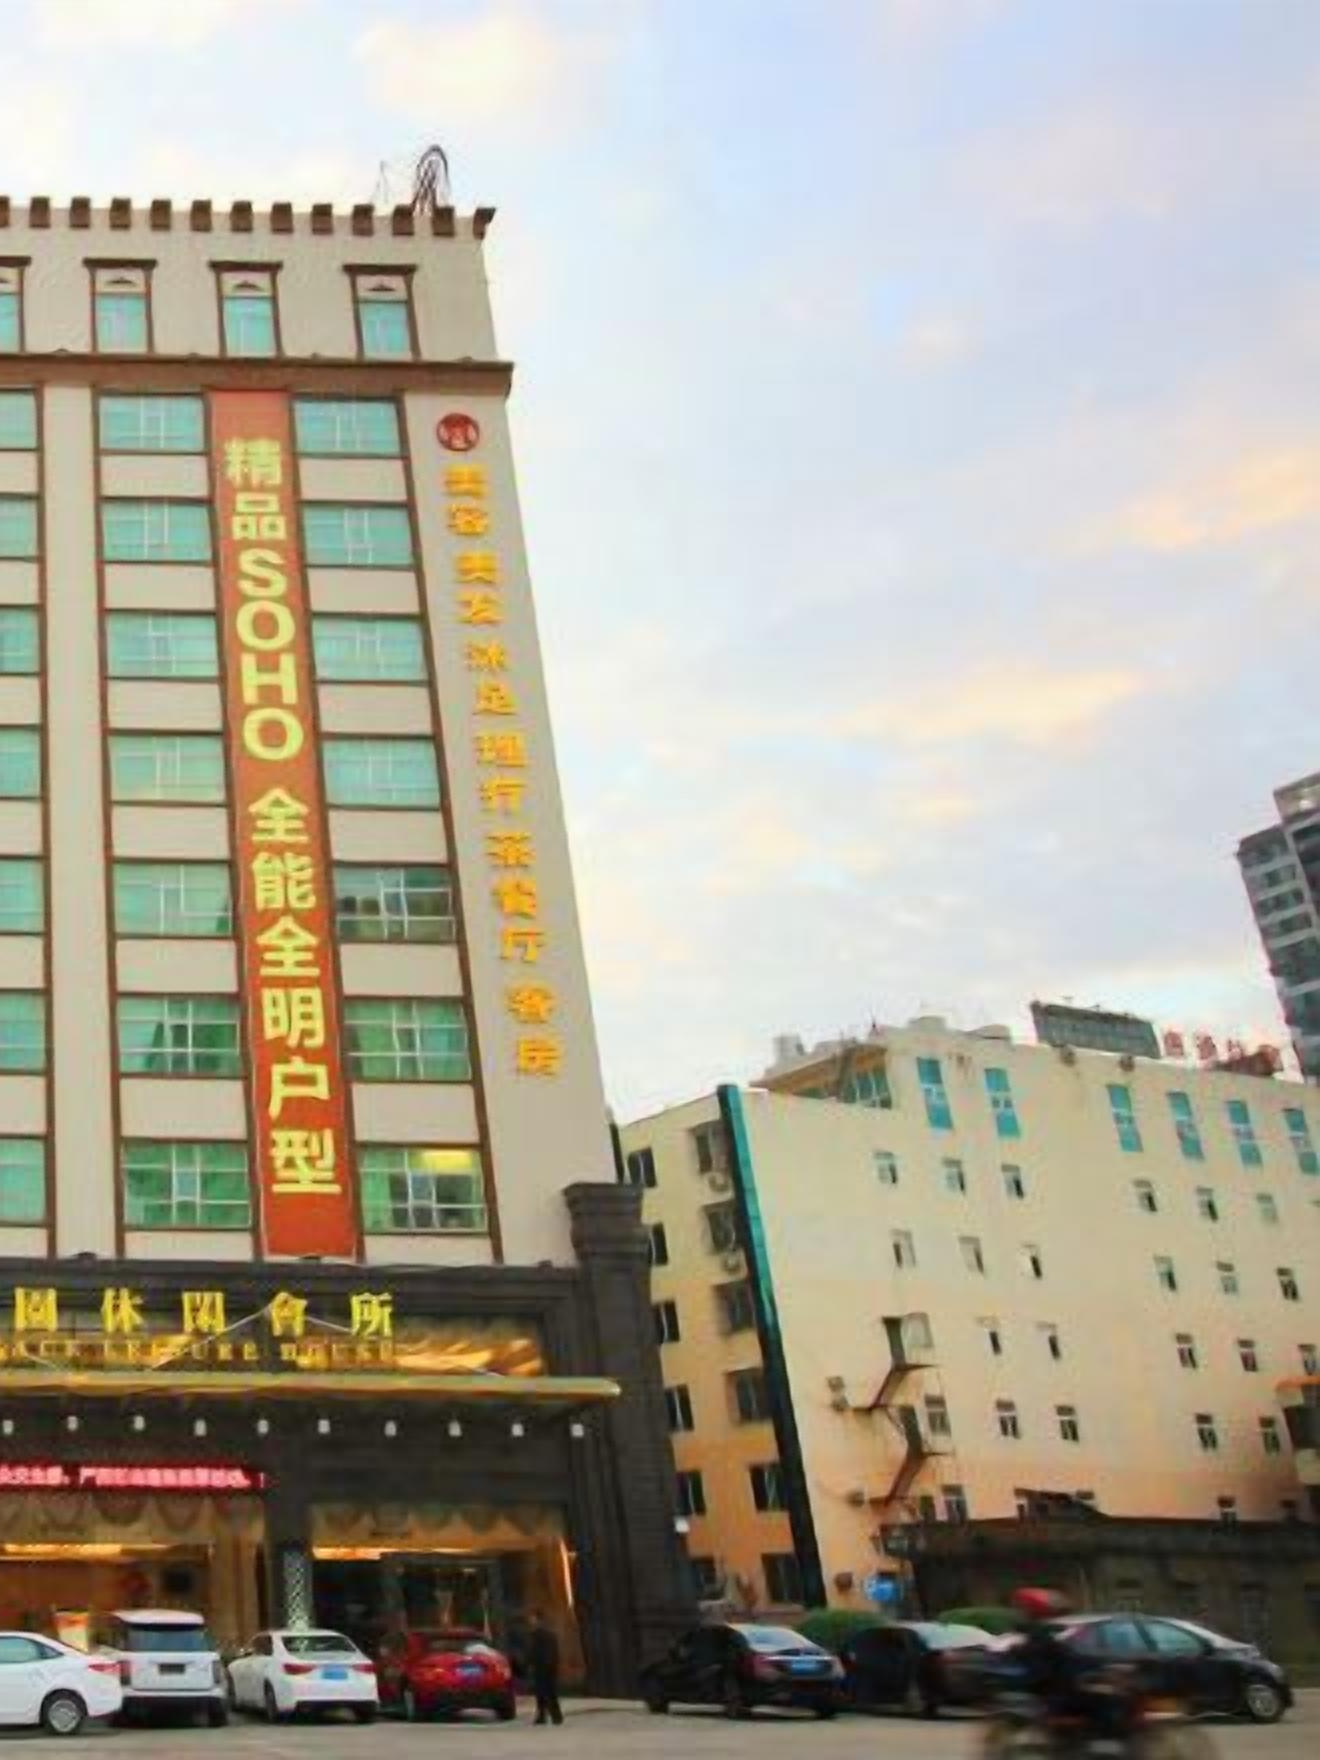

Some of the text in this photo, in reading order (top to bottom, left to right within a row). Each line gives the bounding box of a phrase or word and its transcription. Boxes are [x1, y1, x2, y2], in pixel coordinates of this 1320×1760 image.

[248, 787, 341, 1195] 全能全明户型
